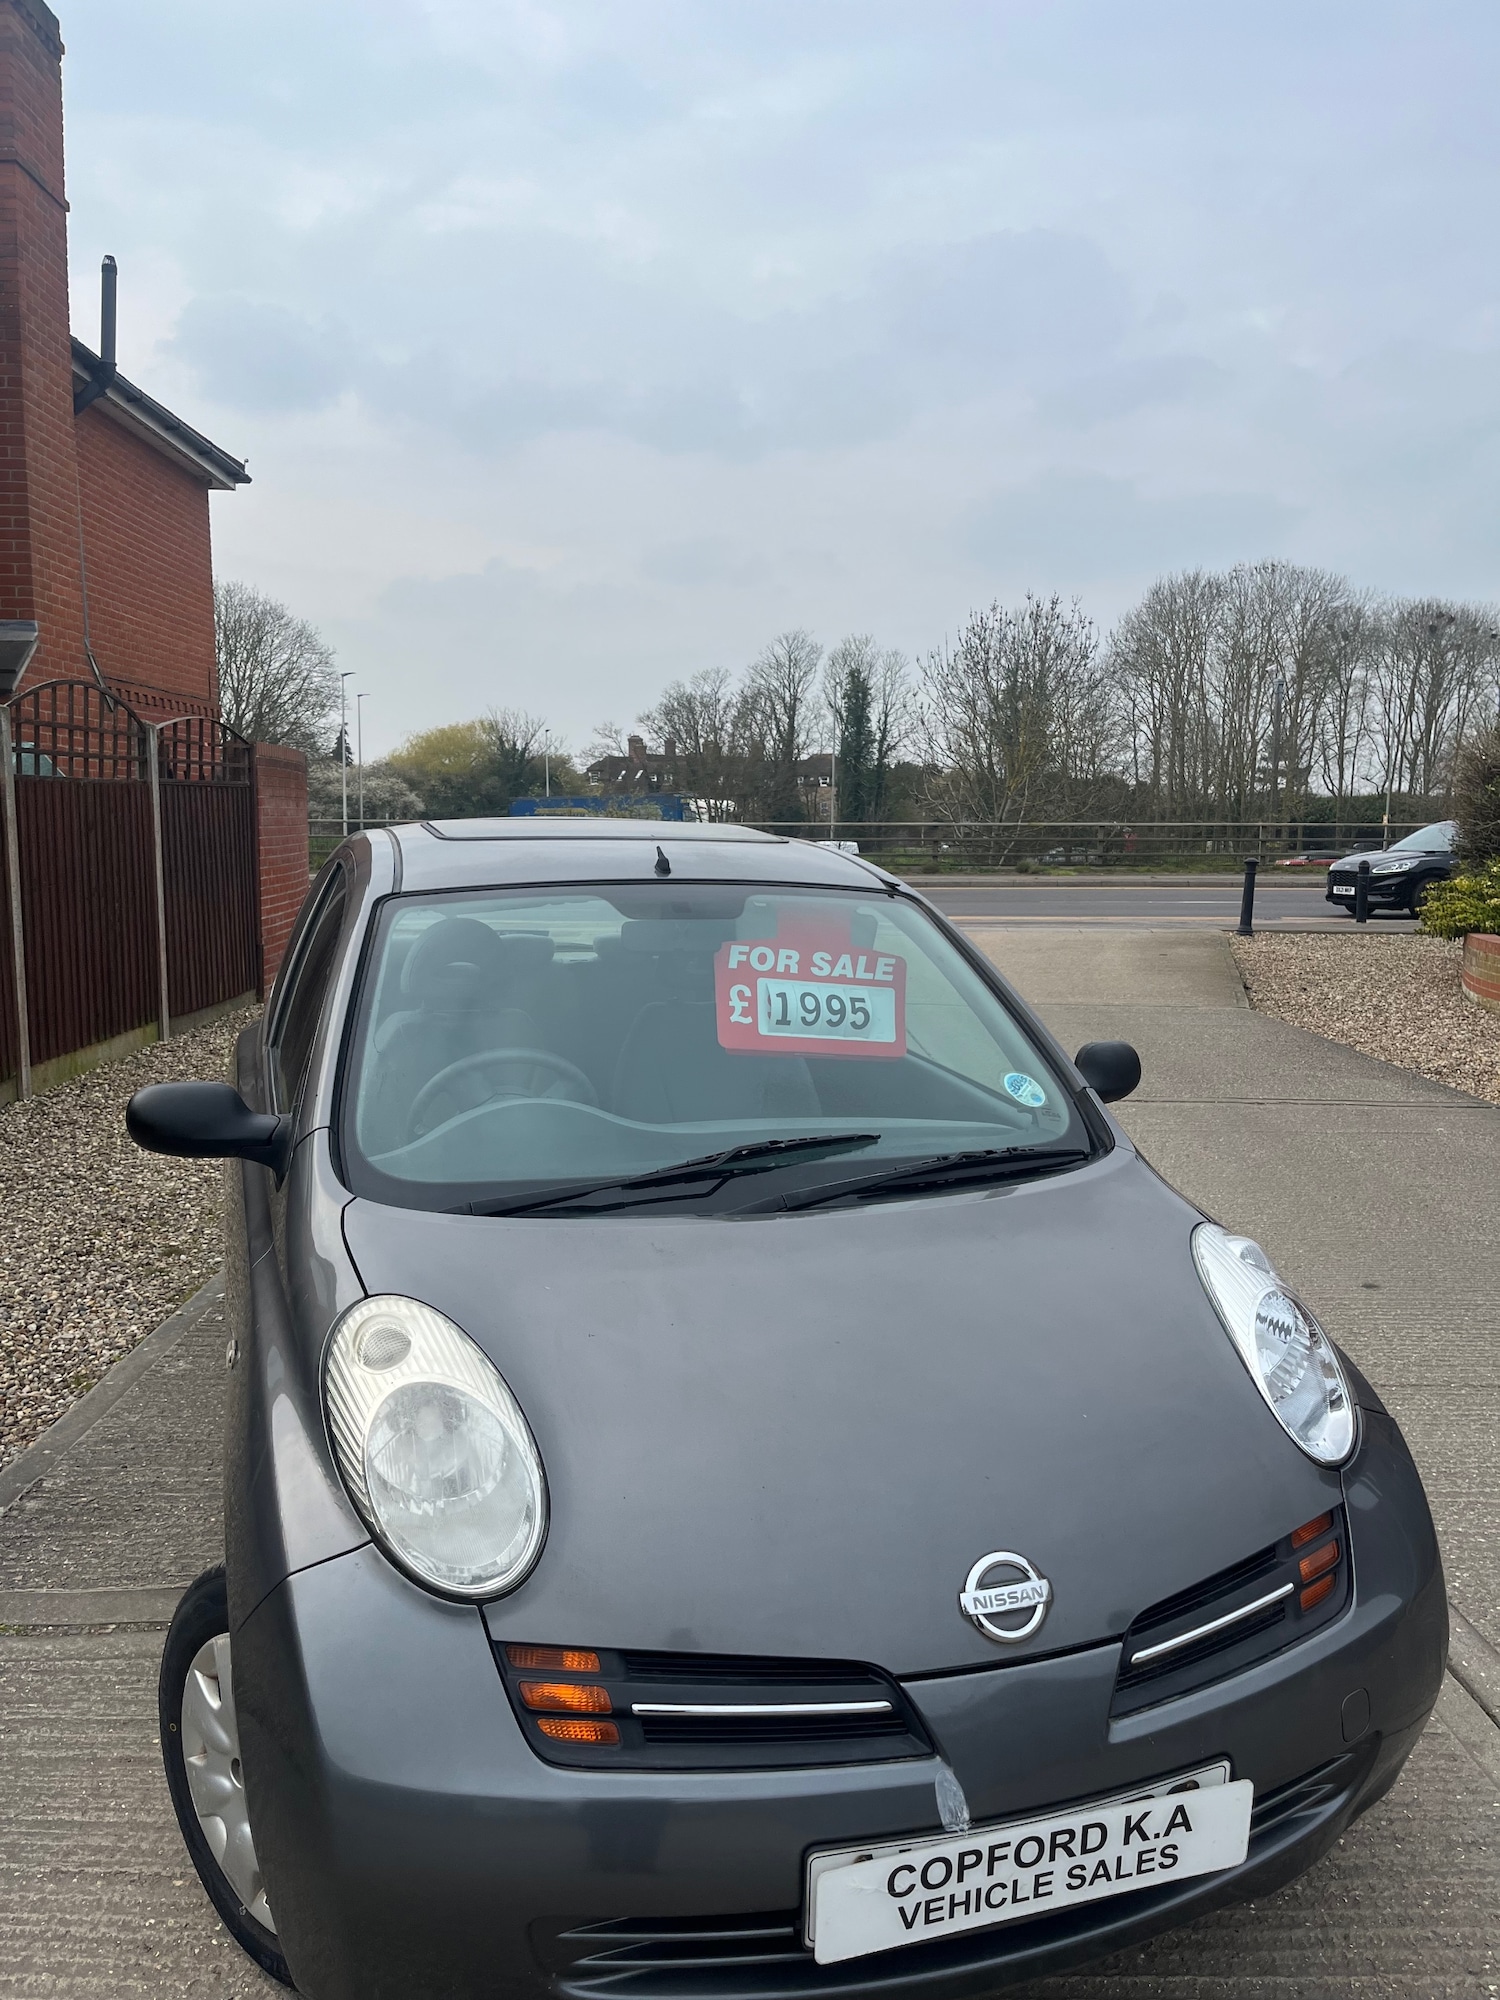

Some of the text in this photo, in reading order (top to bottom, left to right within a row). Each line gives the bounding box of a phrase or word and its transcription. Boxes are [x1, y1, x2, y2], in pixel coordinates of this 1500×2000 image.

[728, 945, 896, 981] FOR SALE
[728, 984, 871, 1030] £ 1995
[972, 1585, 1045, 1611] NISSAN
[887, 1804, 1193, 1898] COPFORD K.A
[898, 1843, 1179, 1930] VEHICLE SALES
